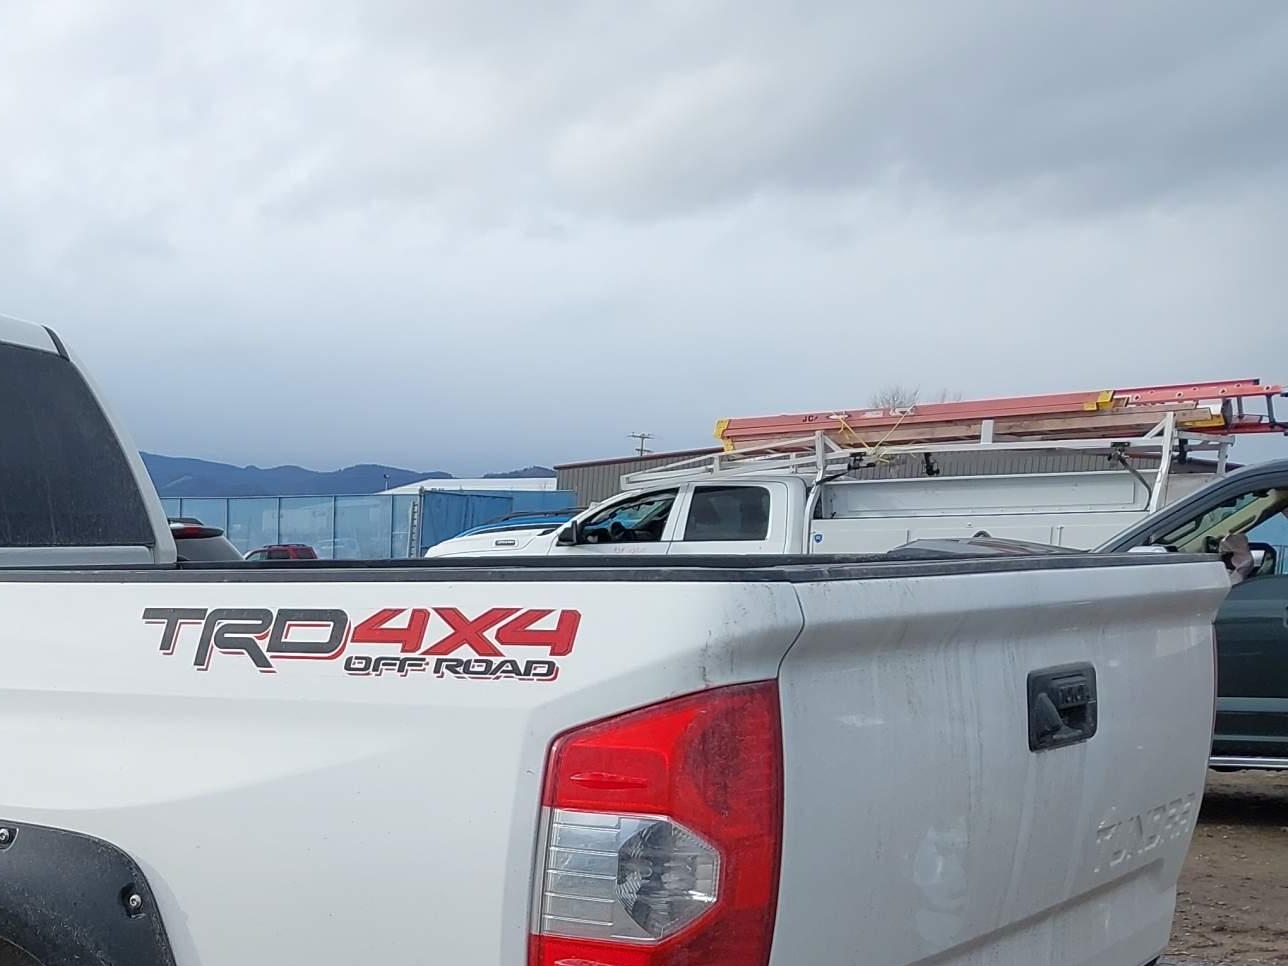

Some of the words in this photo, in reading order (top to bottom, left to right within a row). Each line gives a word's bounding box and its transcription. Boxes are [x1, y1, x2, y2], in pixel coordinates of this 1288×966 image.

[142, 607, 352, 673] TRD
[343, 656, 431, 676] OFF
[433, 657, 559, 680] ROAD
